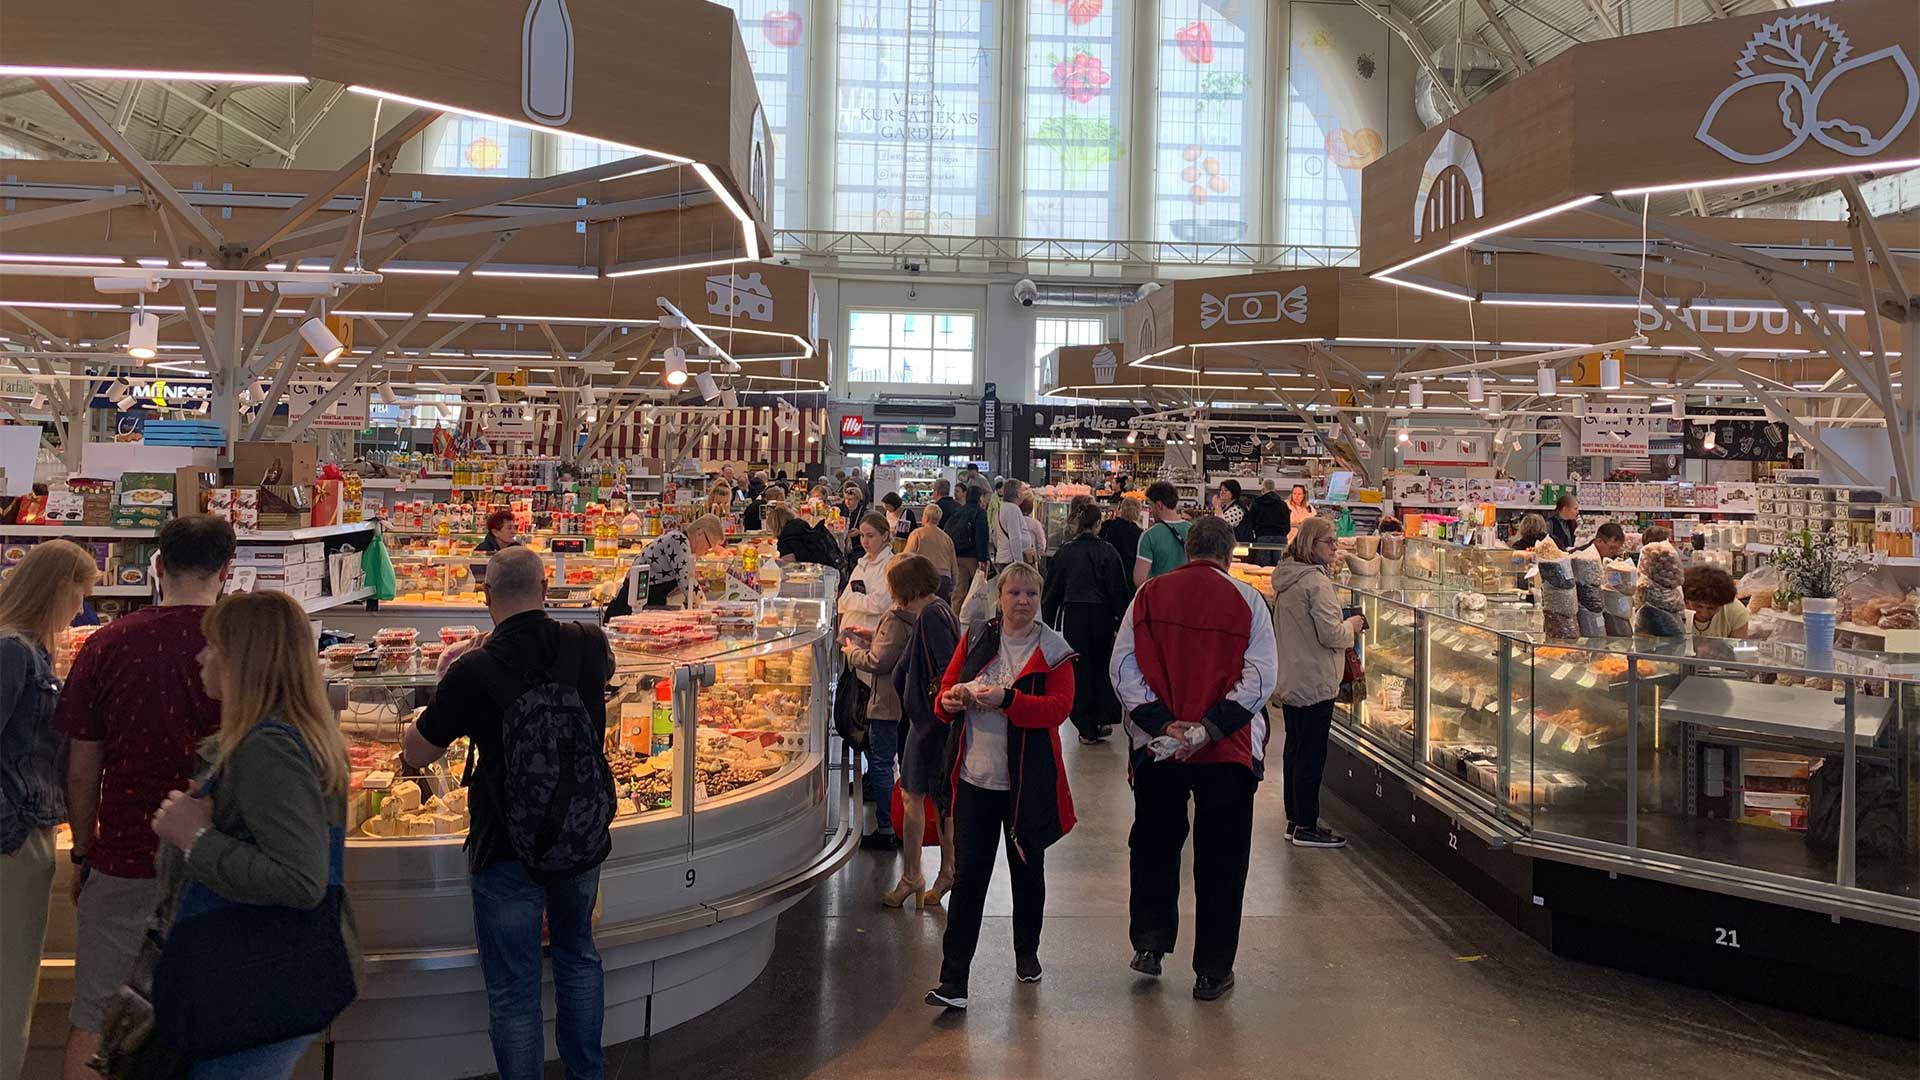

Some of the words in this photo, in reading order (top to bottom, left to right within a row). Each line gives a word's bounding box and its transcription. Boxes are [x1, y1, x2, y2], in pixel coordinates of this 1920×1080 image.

[860, 108, 895, 121] KUR
[842, 416, 862, 436] illy
[1448, 832, 1458, 850] 22
[685, 868, 696, 888] 9
[1715, 927, 1741, 948] 21
